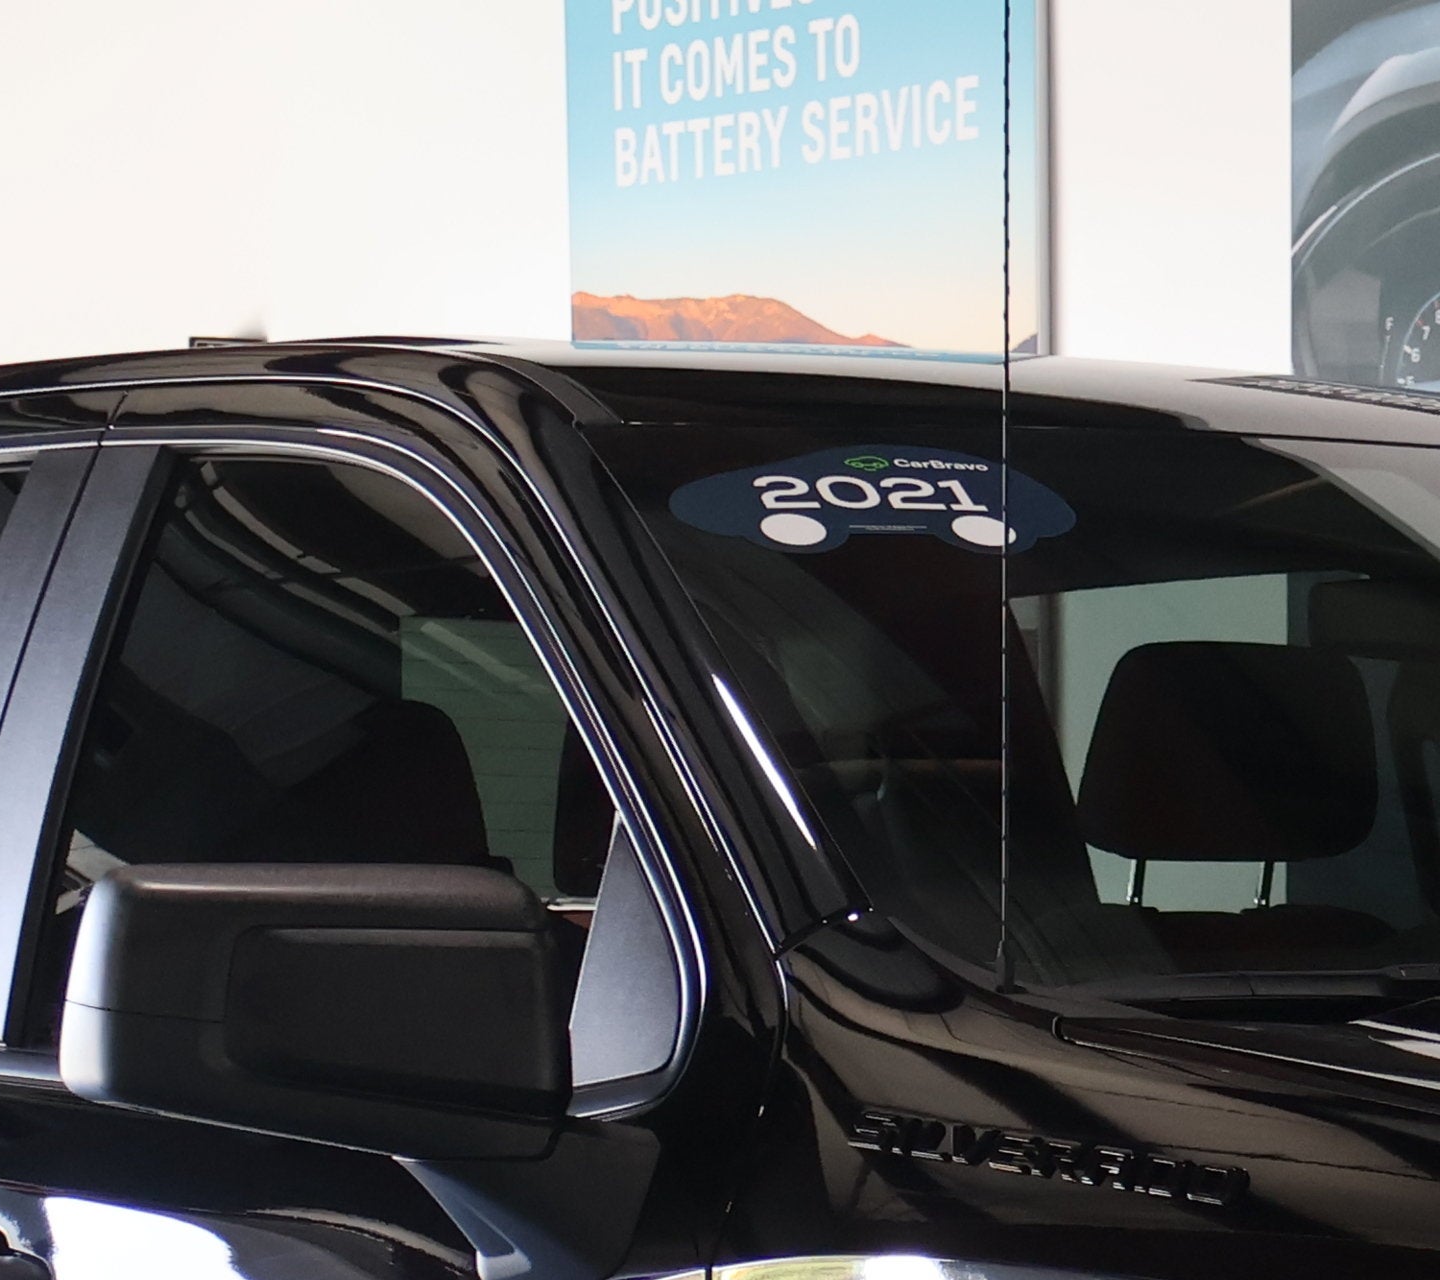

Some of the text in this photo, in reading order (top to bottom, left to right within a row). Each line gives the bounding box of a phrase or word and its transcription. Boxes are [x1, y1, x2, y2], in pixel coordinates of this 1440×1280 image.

[612, 48, 648, 111] IT
[660, 25, 797, 105] COMES
[808, 14, 861, 82] TO
[614, 74, 980, 189] BATTERY SERVICE
[1411, 348, 1420, 363] 6
[752, 475, 990, 512] 2021
[892, 457, 990, 473] CarBravo
[848, 1111, 1251, 1206] SILVERADO
